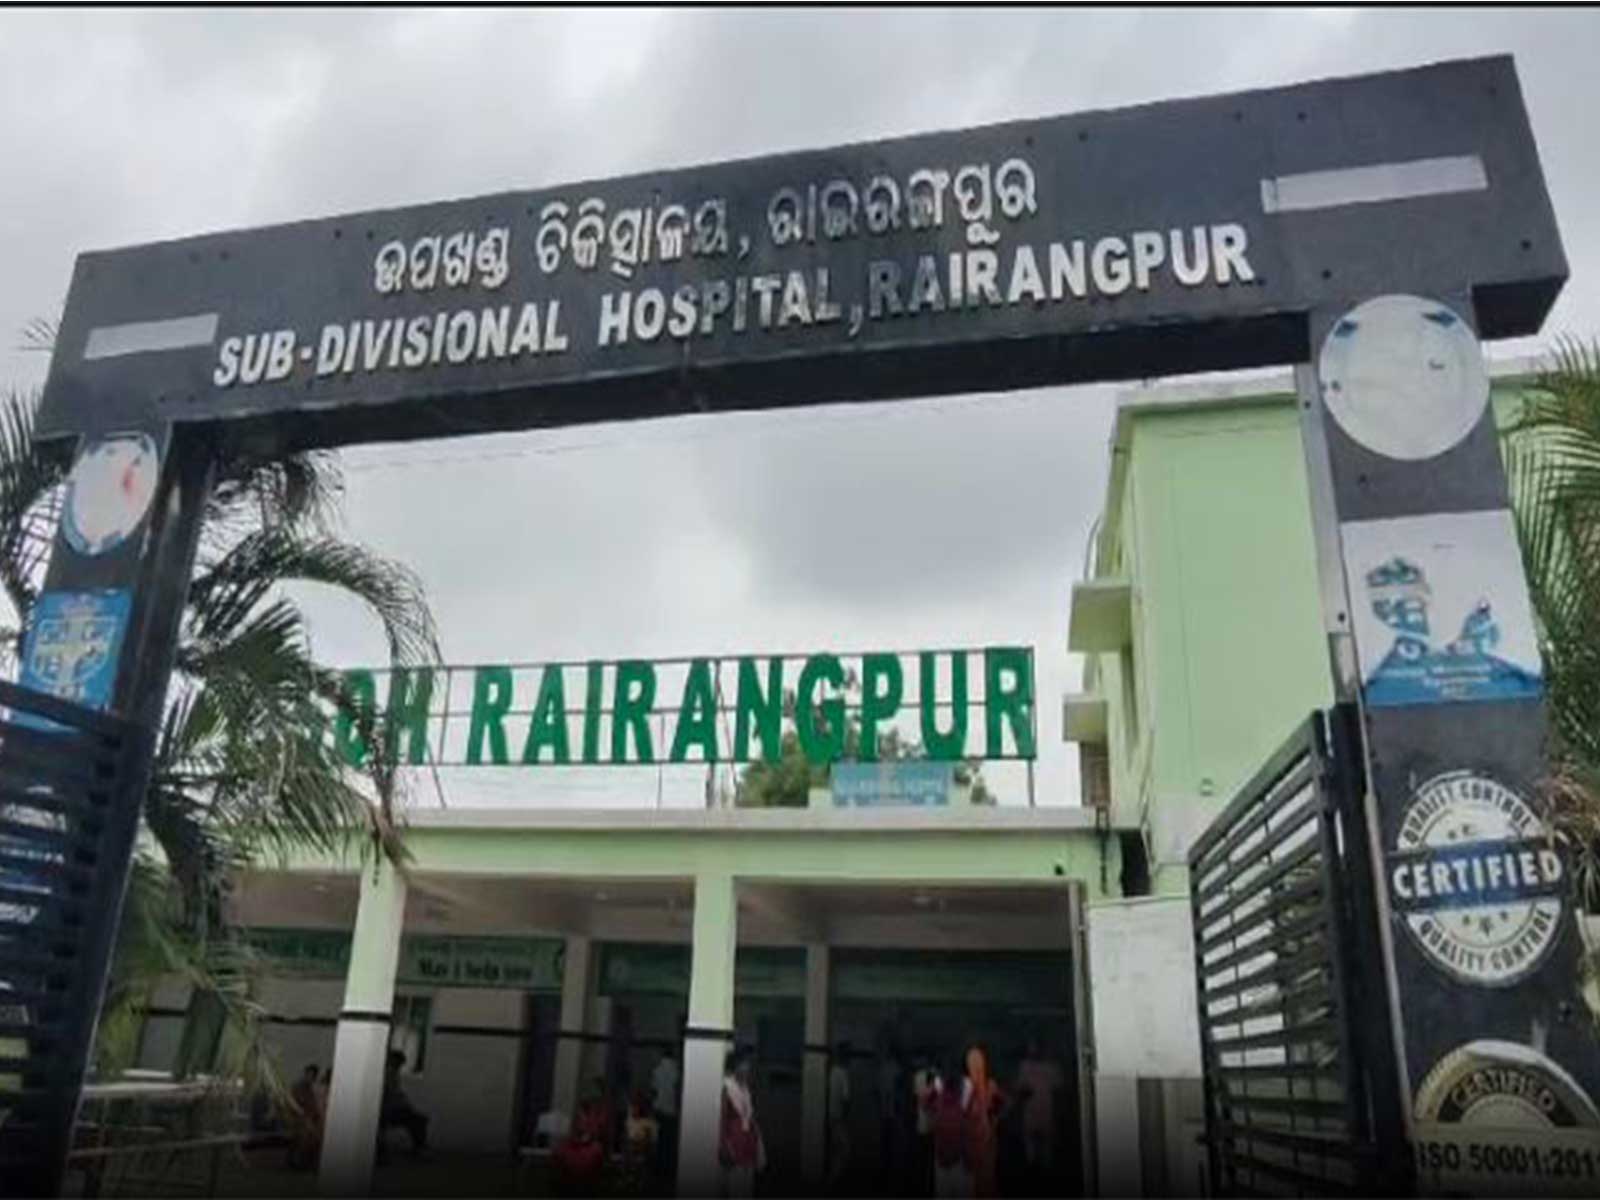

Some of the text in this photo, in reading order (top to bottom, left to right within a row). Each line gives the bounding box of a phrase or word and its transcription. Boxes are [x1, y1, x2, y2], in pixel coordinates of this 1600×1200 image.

[374, 227, 510, 293] ଉପଖଣ୍ଡ
[213, 301, 569, 386] SUB-DIVISIONAL
[466, 648, 1036, 769] RAIRANGPUR
[1392, 850, 1563, 898] CERTIFIED
[1419, 908, 1552, 971] QUALITY CONTROL
[1469, 1143, 1600, 1179] 50001:201
